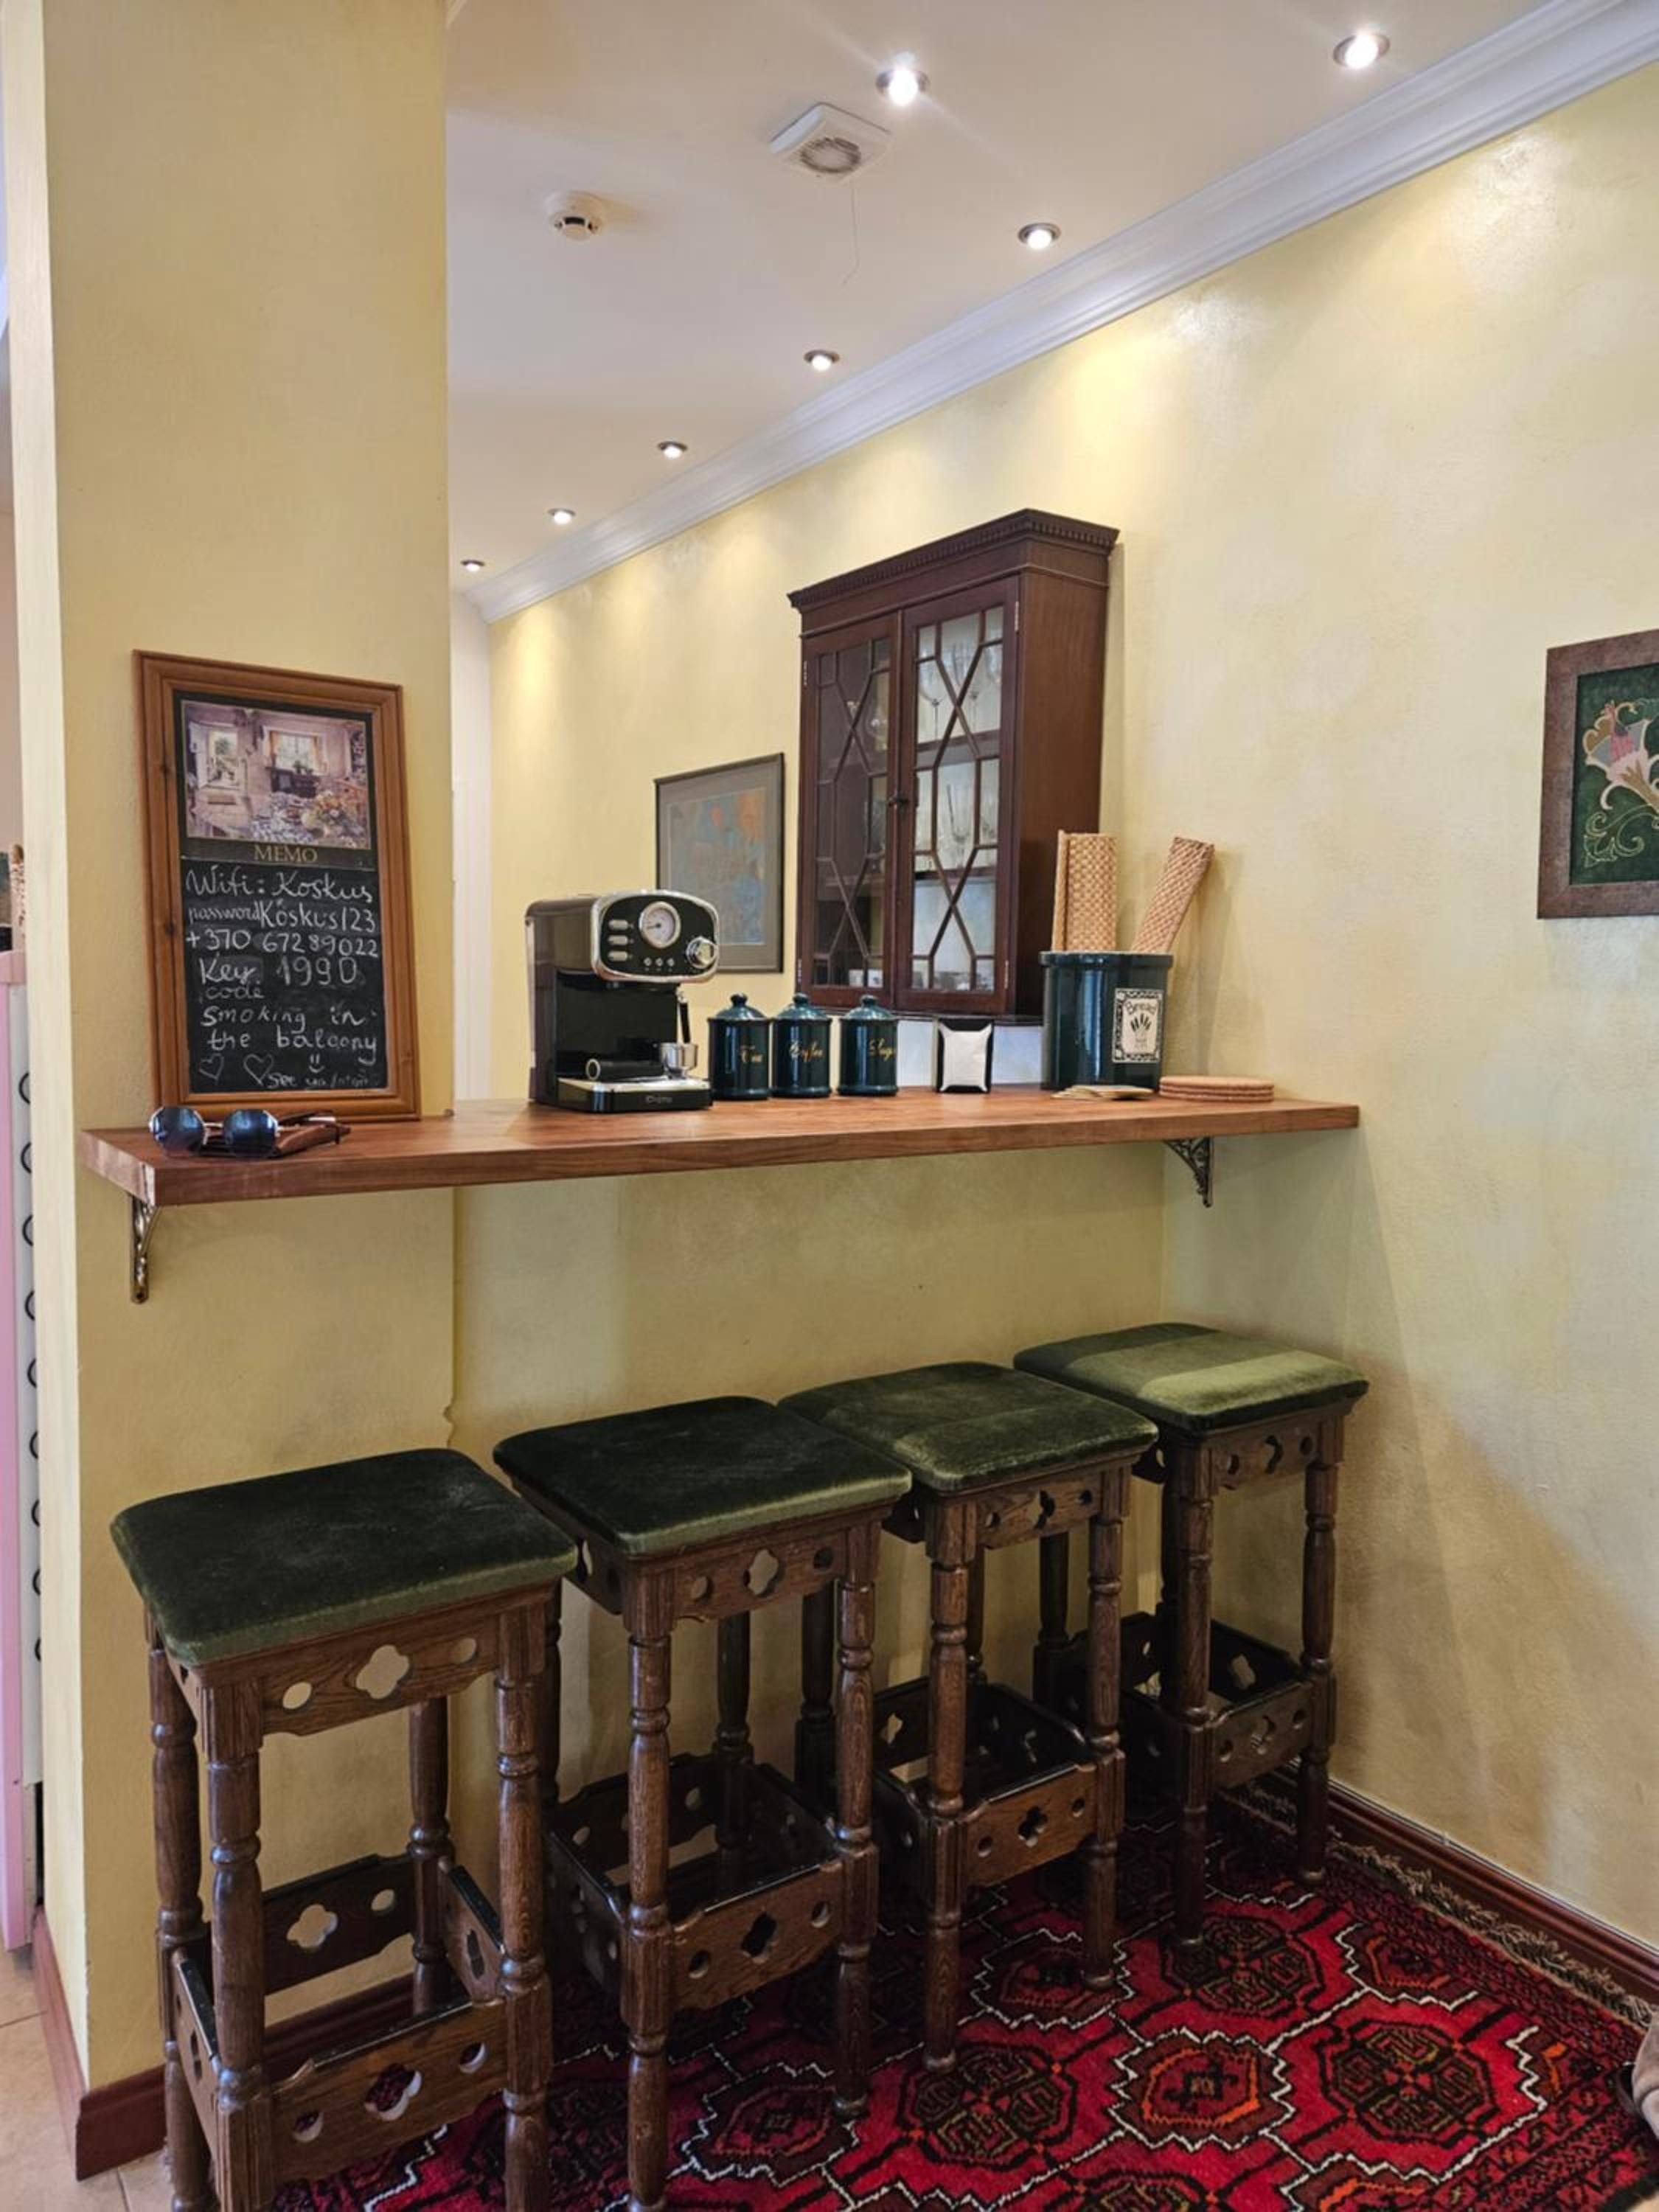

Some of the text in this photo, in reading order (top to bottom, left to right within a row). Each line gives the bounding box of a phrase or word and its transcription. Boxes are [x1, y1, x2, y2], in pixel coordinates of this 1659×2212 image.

[254, 844, 318, 863] MEMO
[271, 871, 372, 903] Koskus
[188, 900, 260, 924] password
[186, 928, 251, 950] +370
[276, 956, 358, 986] 1990
[205, 984, 265, 1000] code
[330, 1006, 366, 1026] in
[207, 1024, 377, 1065] the balcony
